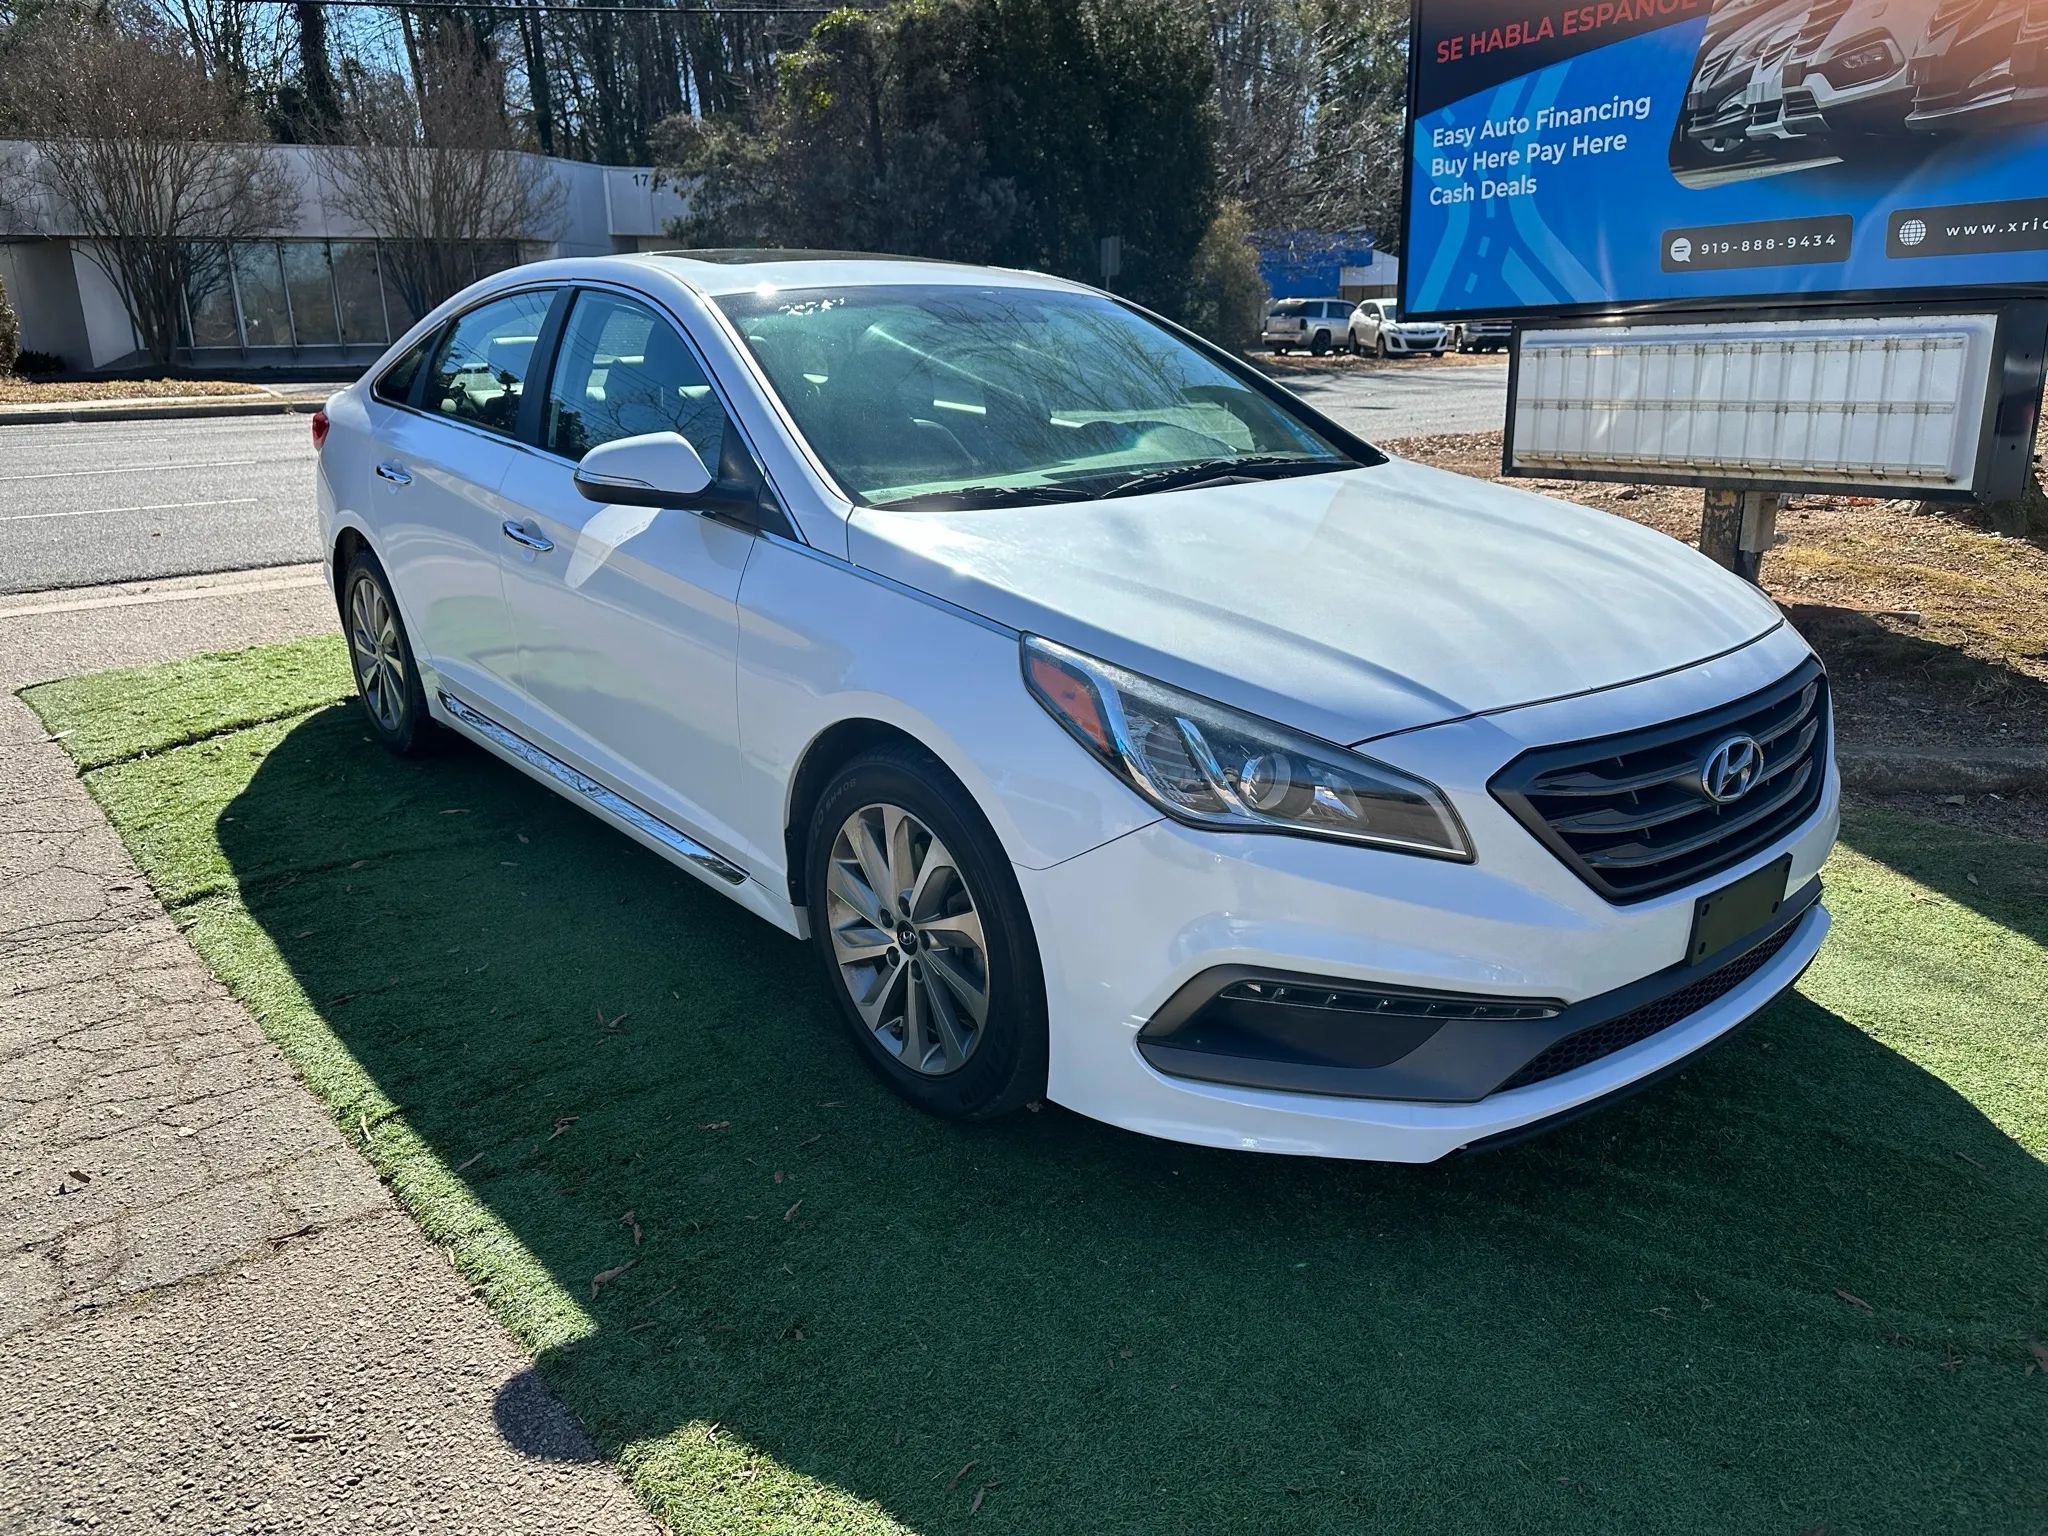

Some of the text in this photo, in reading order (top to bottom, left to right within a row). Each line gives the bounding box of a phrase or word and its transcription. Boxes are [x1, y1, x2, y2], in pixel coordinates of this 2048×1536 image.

[1437, 36, 1464, 63] SE
[1470, 16, 1554, 56] HABLA
[1432, 95, 1651, 148] Easy Auto Financing
[1431, 133, 1627, 178] Buy Here Pay Here
[632, 173, 668, 188] 172
[1429, 175, 1537, 206] Cash Deals
[1701, 234, 1836, 254] 919-888-9434
